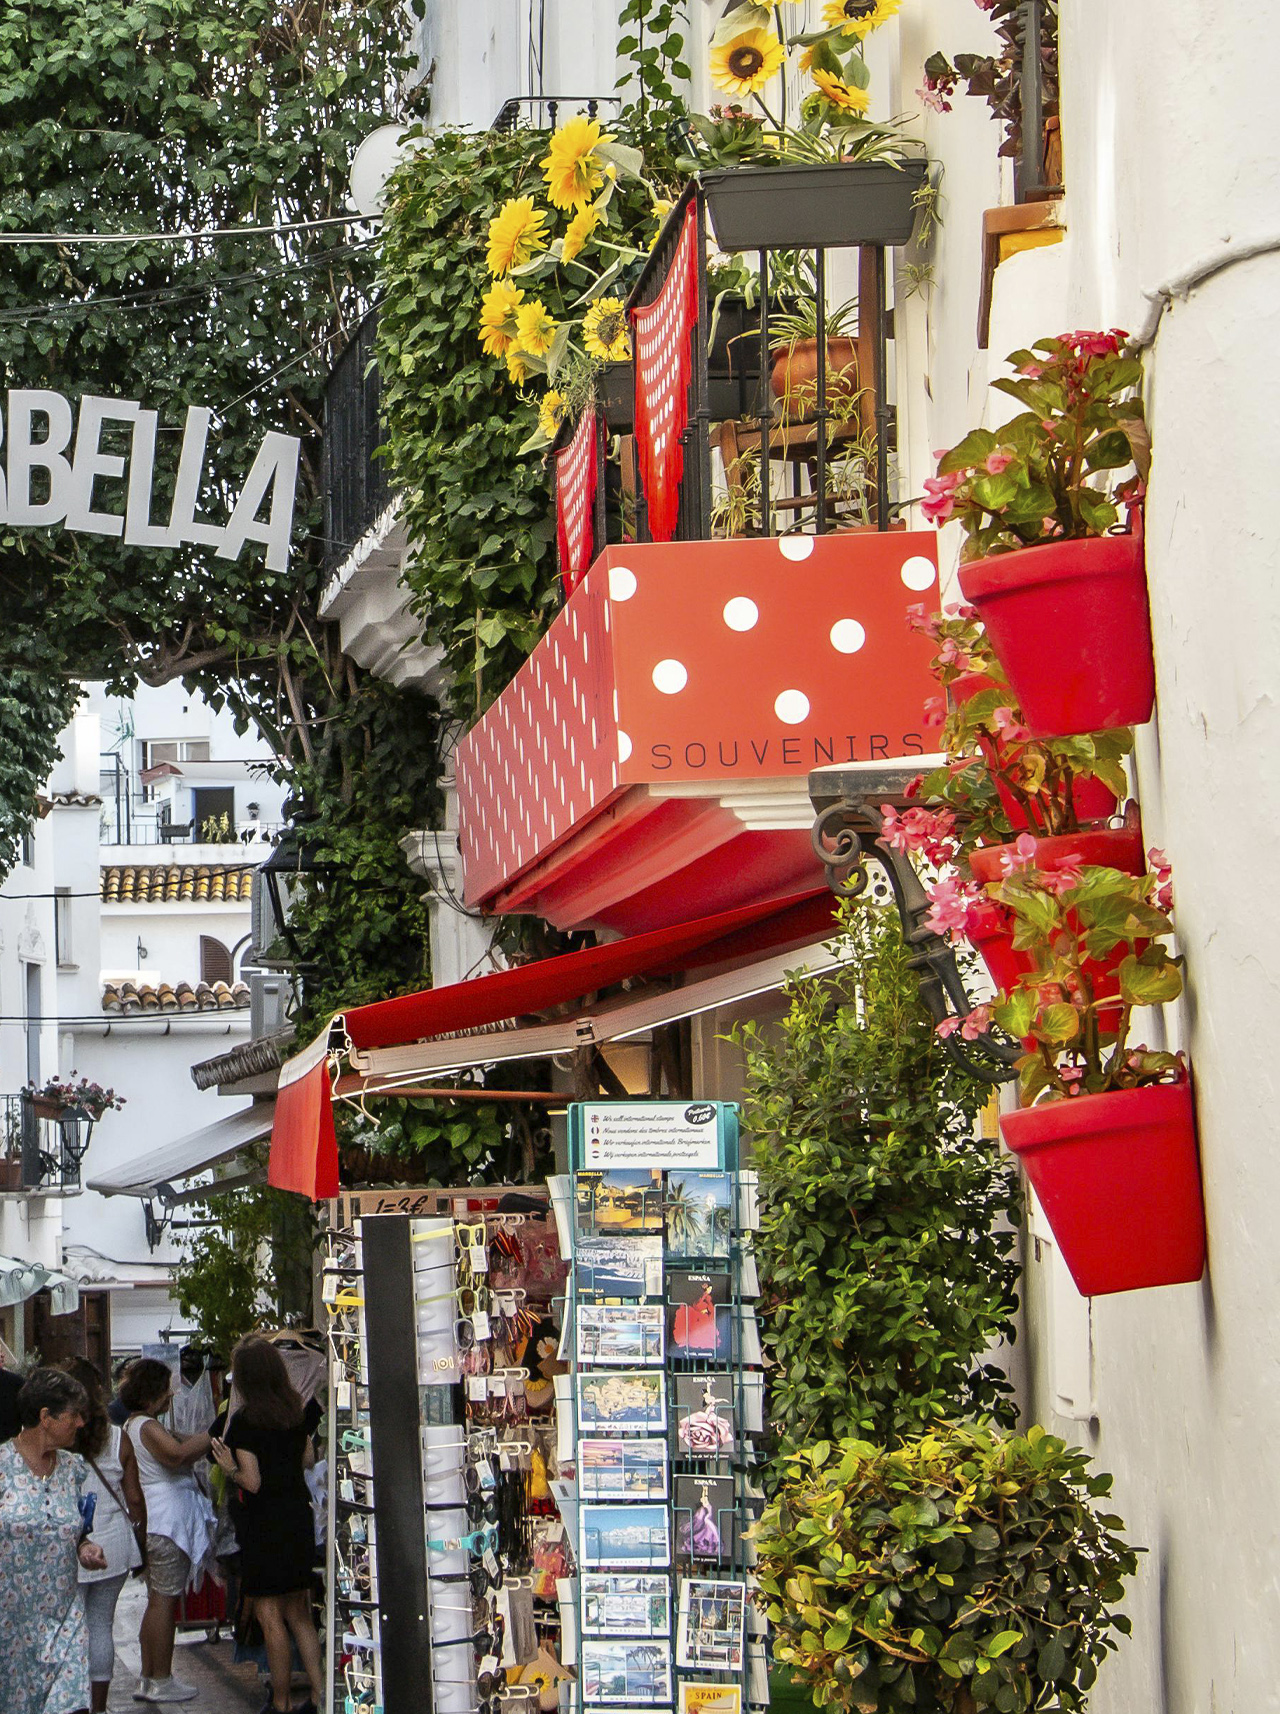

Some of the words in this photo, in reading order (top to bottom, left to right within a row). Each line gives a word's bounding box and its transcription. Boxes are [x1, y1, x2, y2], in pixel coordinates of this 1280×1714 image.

[651, 733, 924, 770] SOUVENIRS
[687, 1274, 711, 1282] ESPAÑA
[692, 1375, 716, 1383] ESPAÑA
[693, 1479, 718, 1487] ESPAÑA
[695, 1692, 722, 1700] SPAIN
